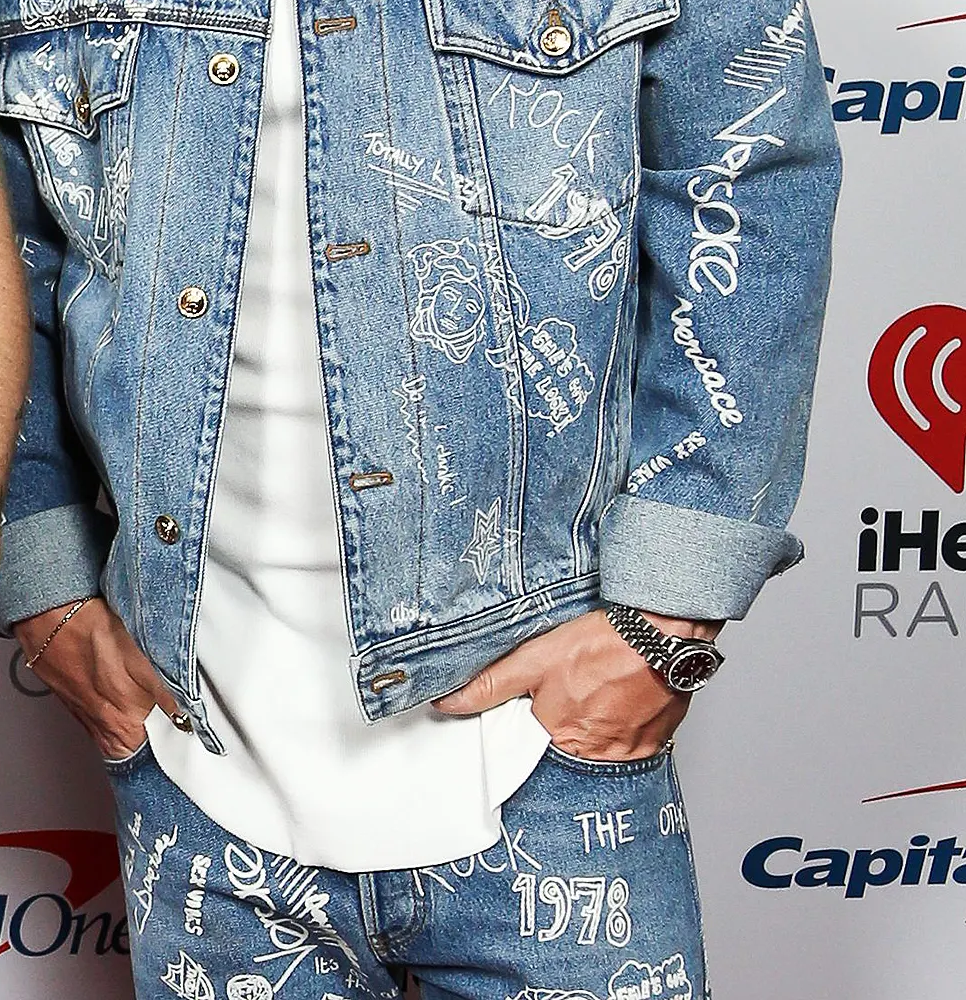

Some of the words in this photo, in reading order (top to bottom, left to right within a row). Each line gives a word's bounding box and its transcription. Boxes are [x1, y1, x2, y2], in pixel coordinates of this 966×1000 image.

[824, 66, 966, 134] api
[854, 581, 959, 638] RA
[574, 809, 635, 853] THE
[741, 834, 966, 899] Capit
[511, 872, 632, 948] 1978
